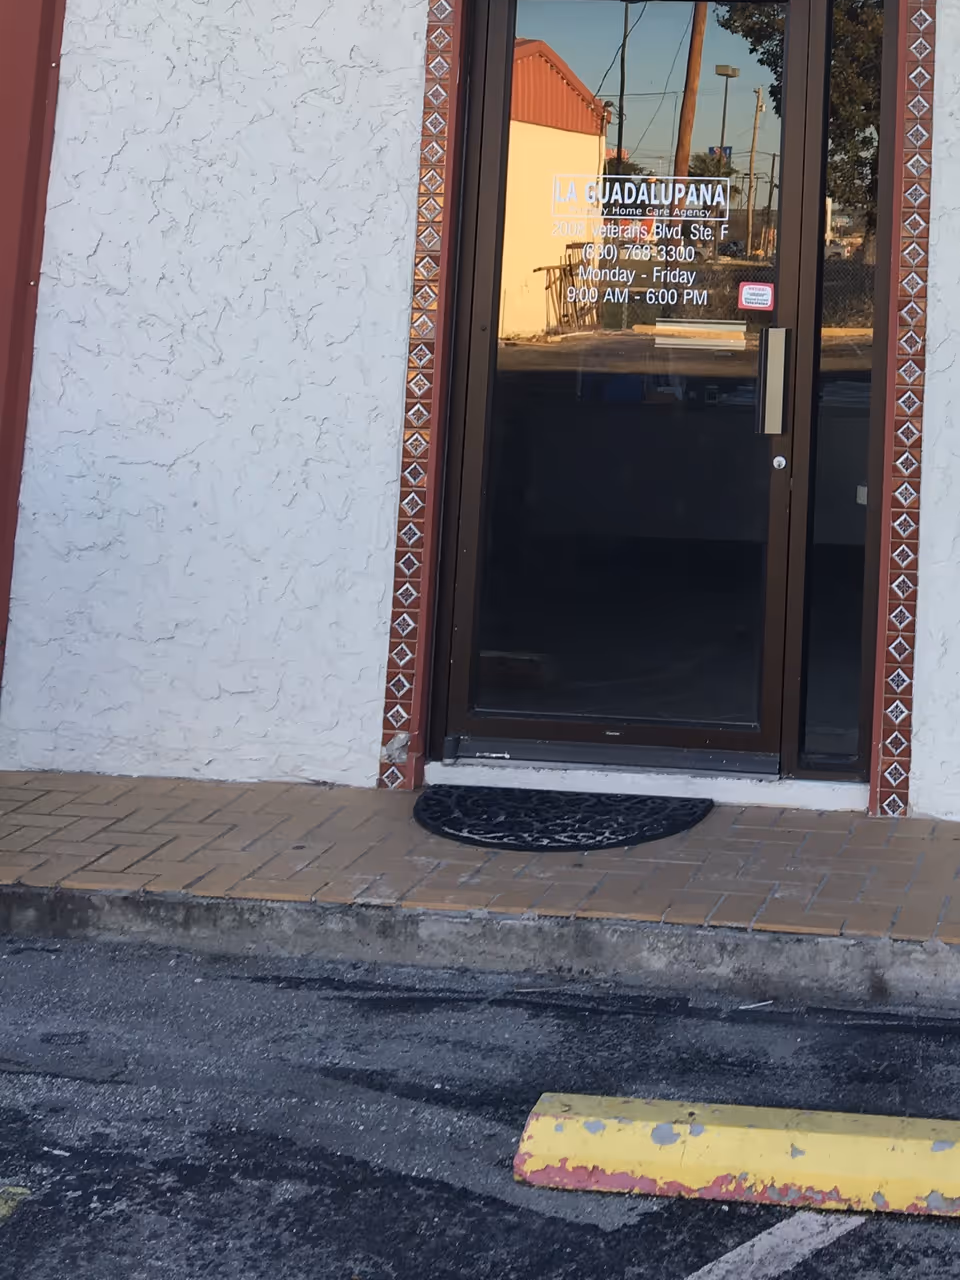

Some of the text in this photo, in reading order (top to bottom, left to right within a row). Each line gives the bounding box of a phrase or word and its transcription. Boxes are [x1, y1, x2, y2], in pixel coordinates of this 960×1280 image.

[556, 181, 725, 206] LA GUADALUPANA
[612, 207, 642, 215] Home
[646, 207, 670, 216] Care
[673, 208, 711, 217] Agency
[654, 223, 684, 239] Blvd.
[690, 224, 715, 240] Ste.
[721, 225, 729, 240] F
[582, 244, 695, 263] (830) 768-3300
[578, 265, 636, 285] Monday
[653, 266, 696, 287] Friday
[567, 286, 598, 303] 9:00
[603, 288, 629, 303] AM
[646, 289, 677, 305] 6:00
[683, 289, 708, 306] PM
